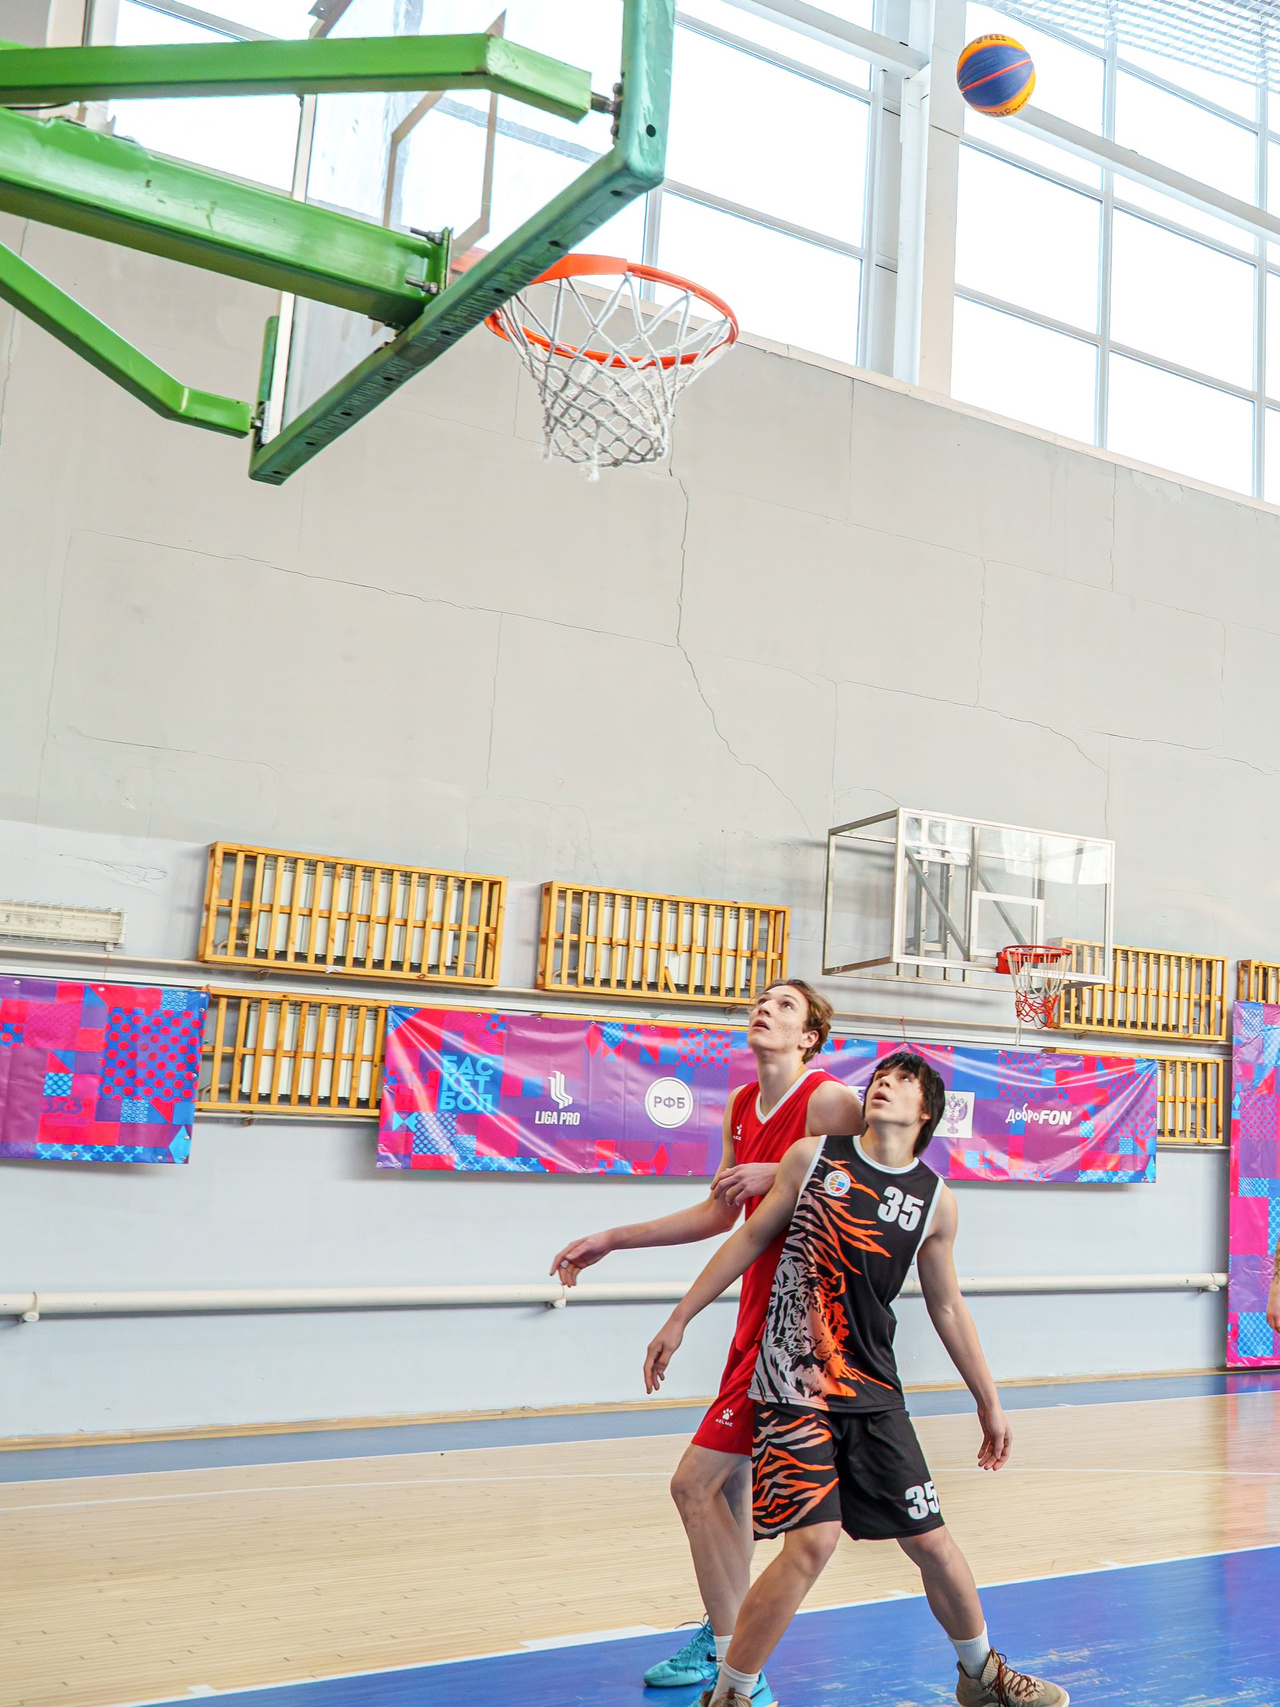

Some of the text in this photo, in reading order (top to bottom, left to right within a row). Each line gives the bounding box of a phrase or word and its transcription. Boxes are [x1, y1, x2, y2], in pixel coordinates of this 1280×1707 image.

[443, 1054, 495, 1076] БАС
[440, 1074, 491, 1096] КЕТ
[439, 1093, 493, 1113] БОЛ
[653, 1095, 686, 1109] РФБ
[534, 1110, 581, 1126] LIGA PRO
[877, 1185, 925, 1232] 35
[904, 1480, 941, 1521] 35
